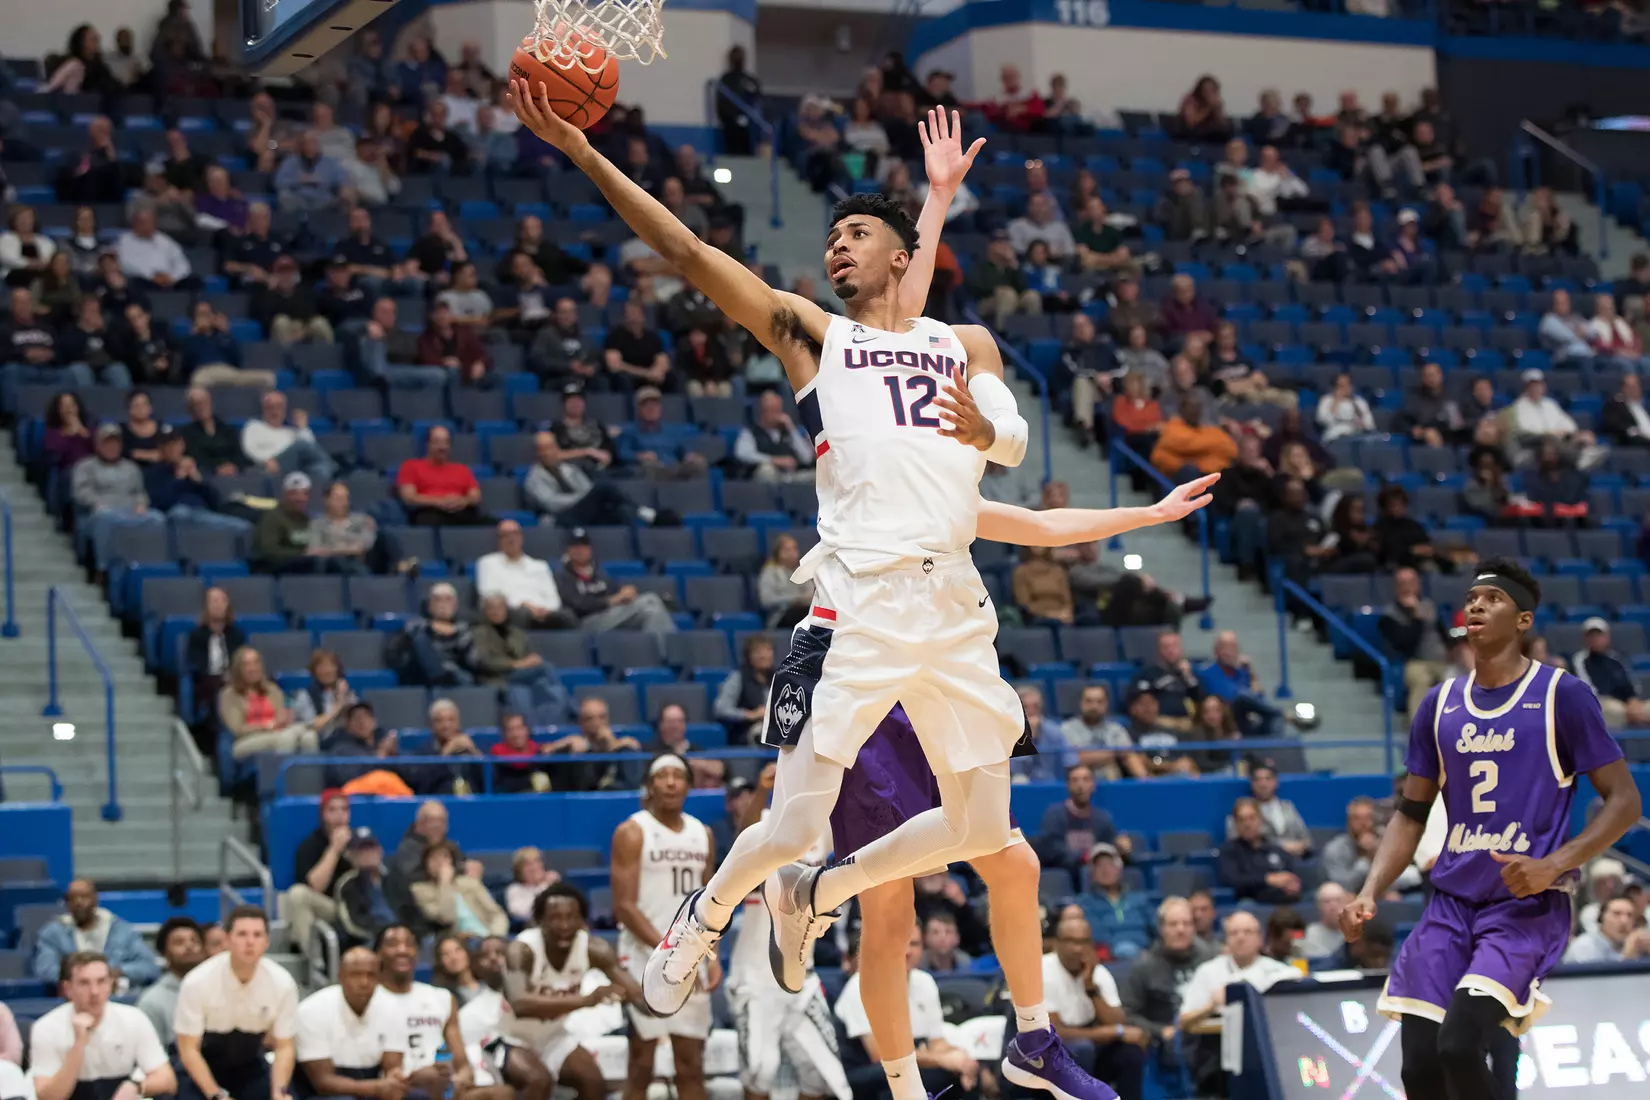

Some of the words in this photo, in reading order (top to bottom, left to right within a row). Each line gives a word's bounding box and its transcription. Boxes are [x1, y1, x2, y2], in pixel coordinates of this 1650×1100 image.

[883, 374, 941, 429] 12
[1456, 722, 1515, 753] Saint
[1469, 760, 1499, 813] 2
[1448, 822, 1531, 854] Michael's
[672, 866, 694, 897] 10
[1339, 1000, 1369, 1033] B
[408, 1033, 425, 1060] 5
[1516, 1019, 1650, 1091] EA
[1298, 1055, 1330, 1088] N
